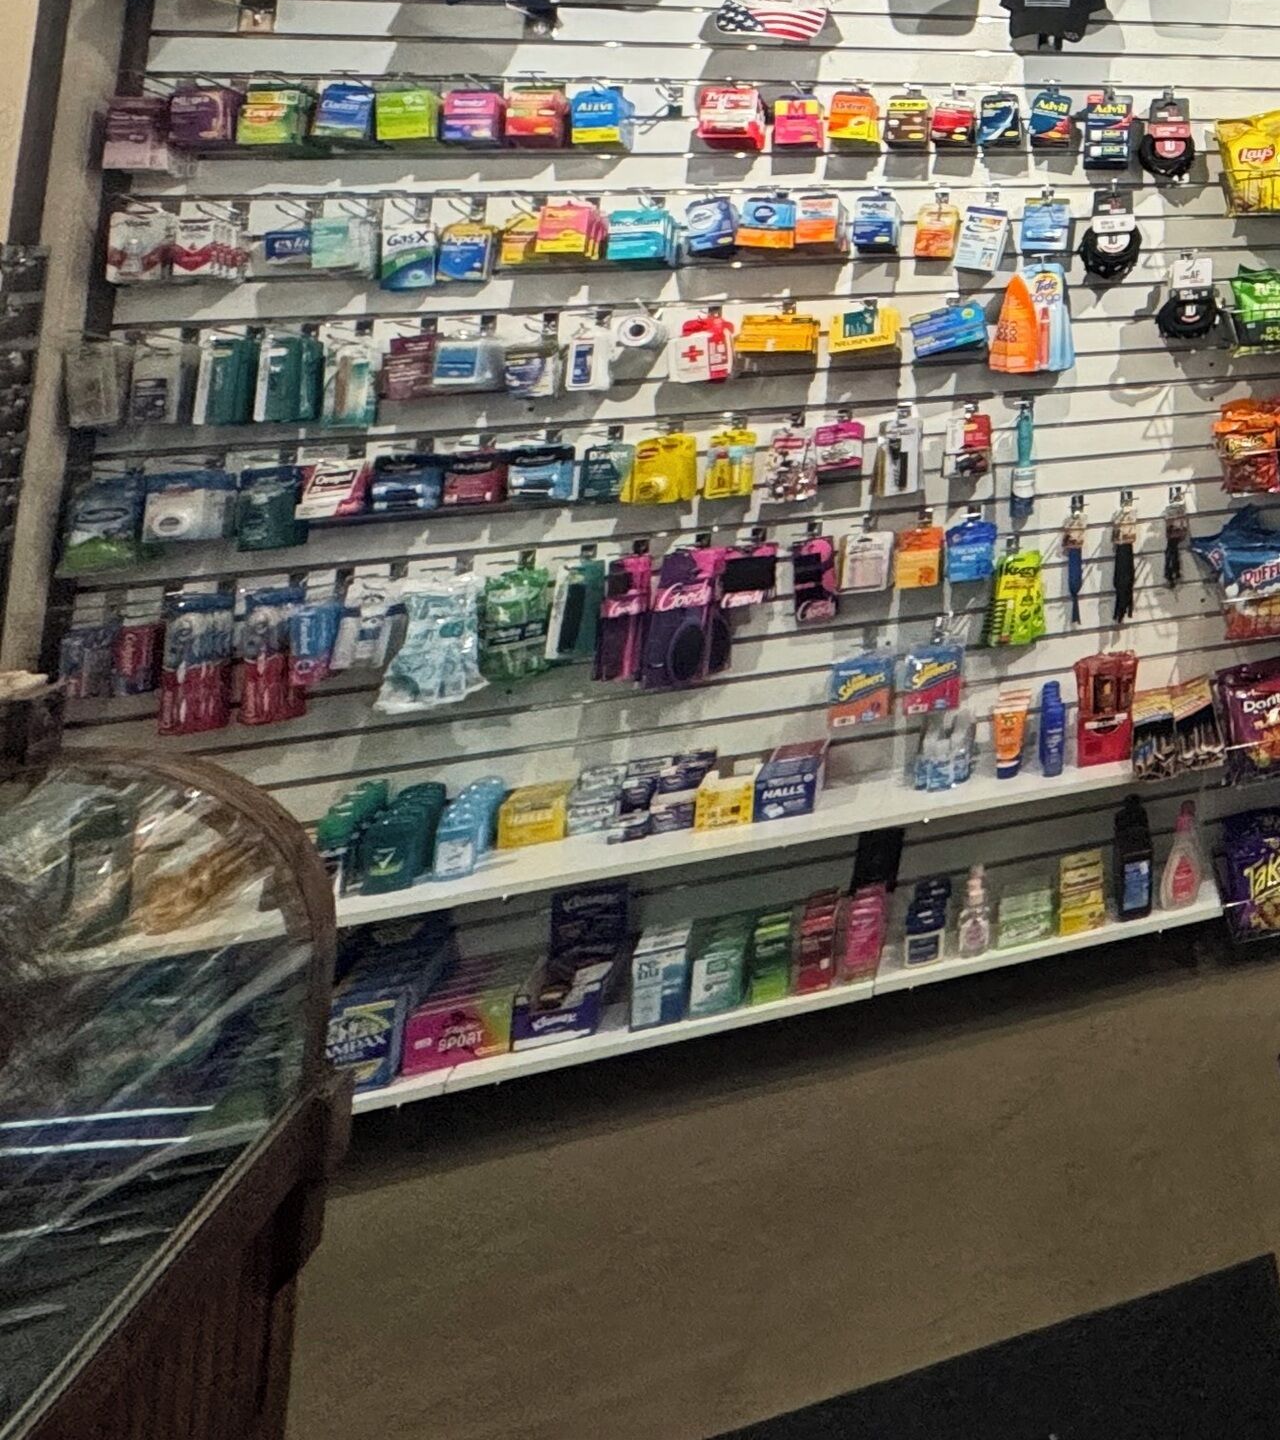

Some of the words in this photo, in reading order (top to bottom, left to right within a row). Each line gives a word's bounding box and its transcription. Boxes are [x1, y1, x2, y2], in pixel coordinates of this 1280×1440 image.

[1036, 98, 1068, 113] Advil
[1094, 103, 1127, 115] Advil
[1035, 277, 1059, 294] Tide
[762, 784, 805, 800] HALLS
[326, 1034, 387, 1060] AMPAX
[437, 1030, 483, 1053] SPORT
